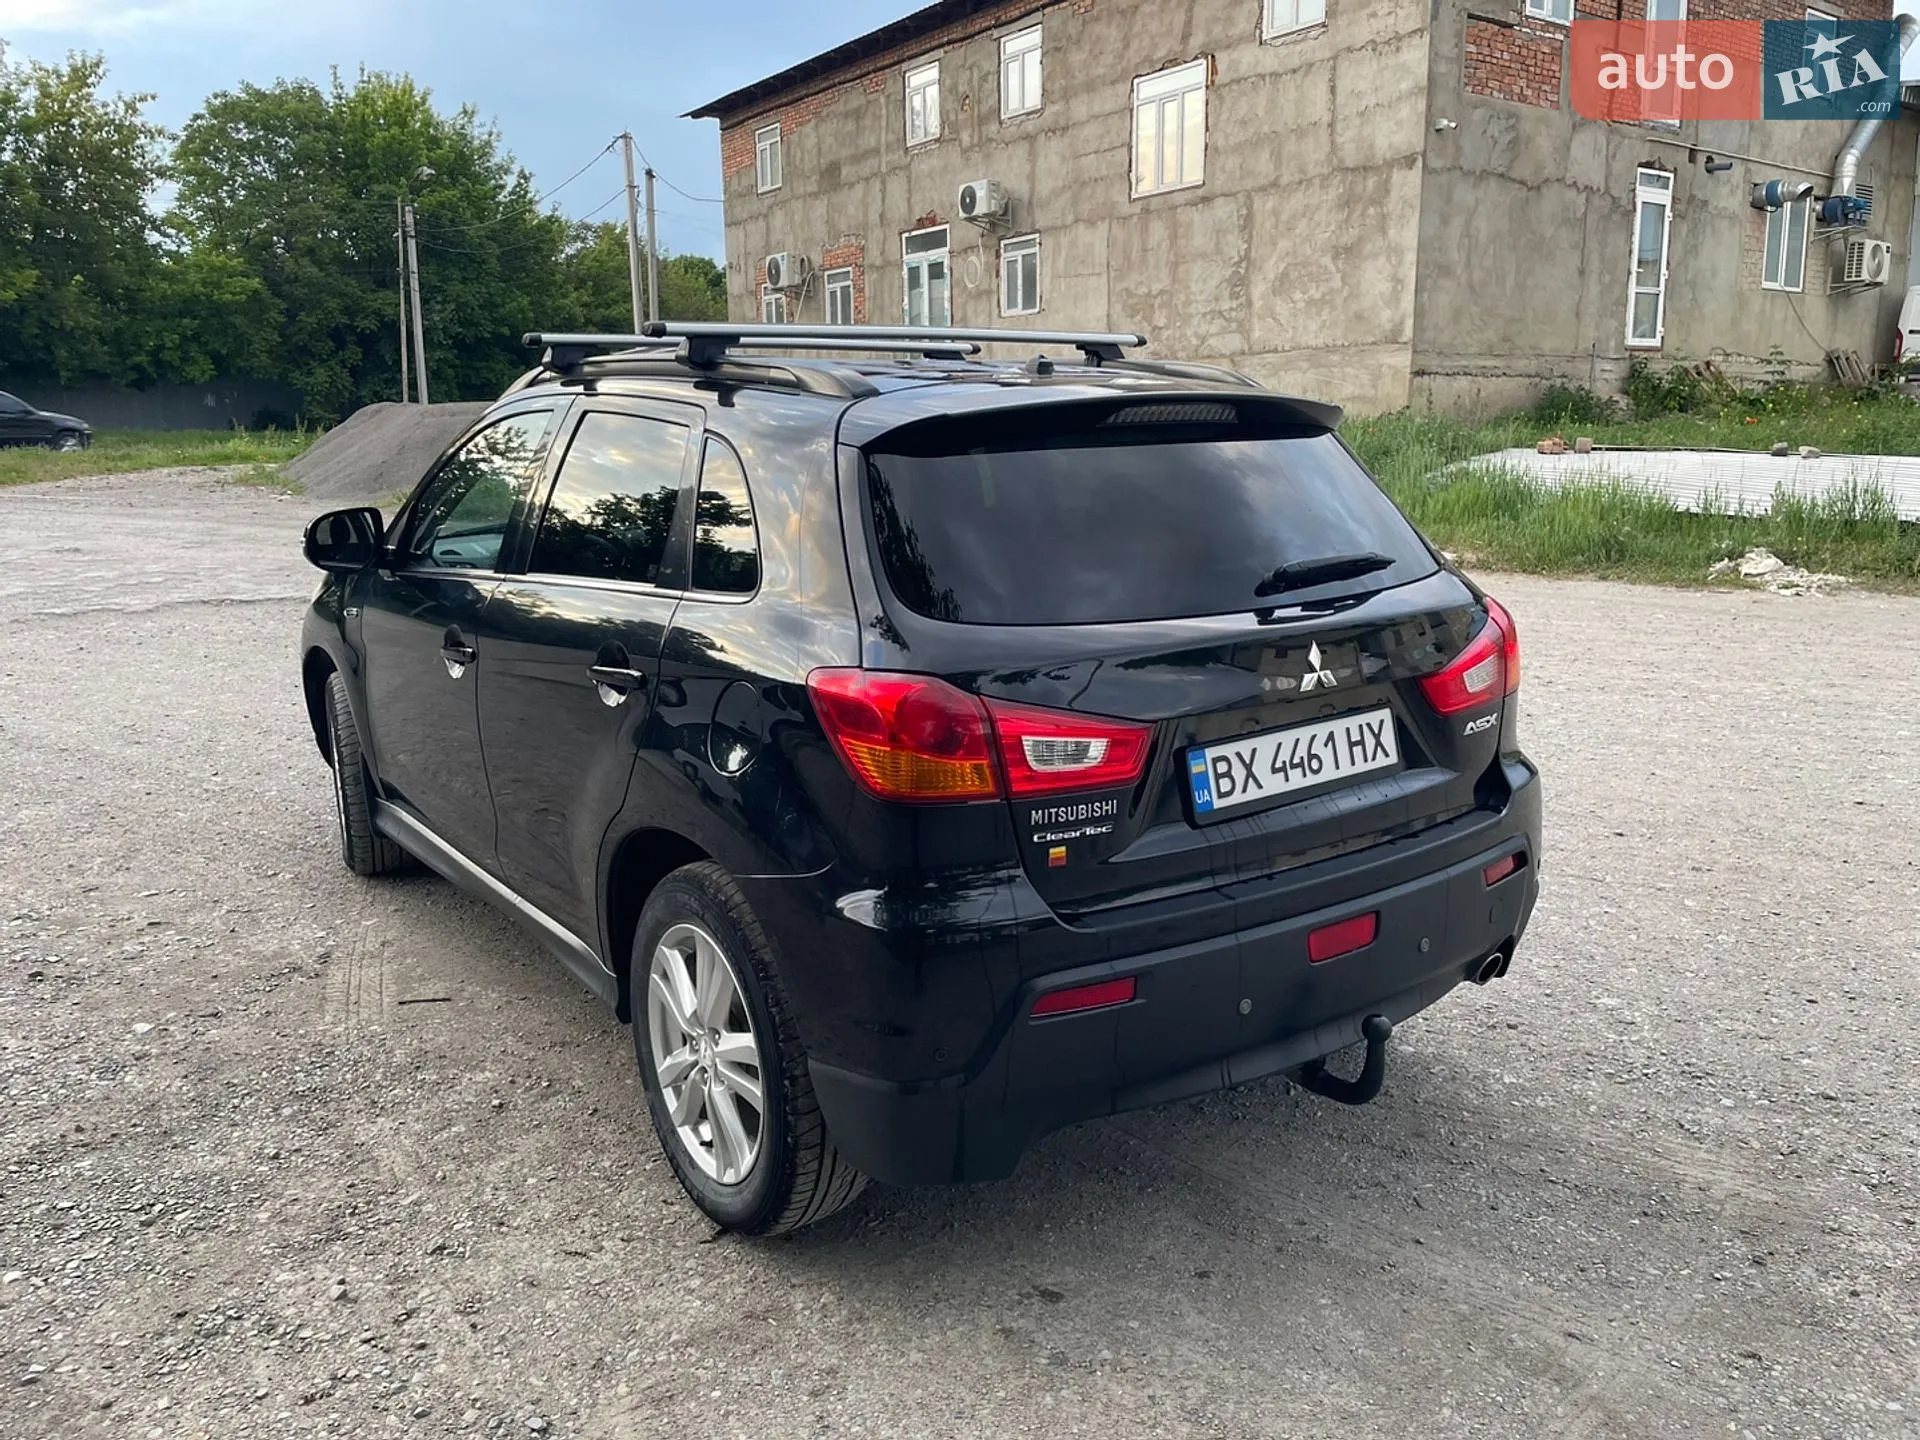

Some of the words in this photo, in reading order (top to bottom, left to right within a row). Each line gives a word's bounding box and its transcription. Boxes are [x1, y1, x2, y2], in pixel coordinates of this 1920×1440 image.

[1463, 712, 1498, 735] ASX
[1212, 747, 1264, 800] BX
[1271, 730, 1340, 783] 4461
[1346, 718, 1390, 767] HX
[1195, 789, 1212, 804] UA
[1031, 800, 1117, 825] MITSUBISHI
